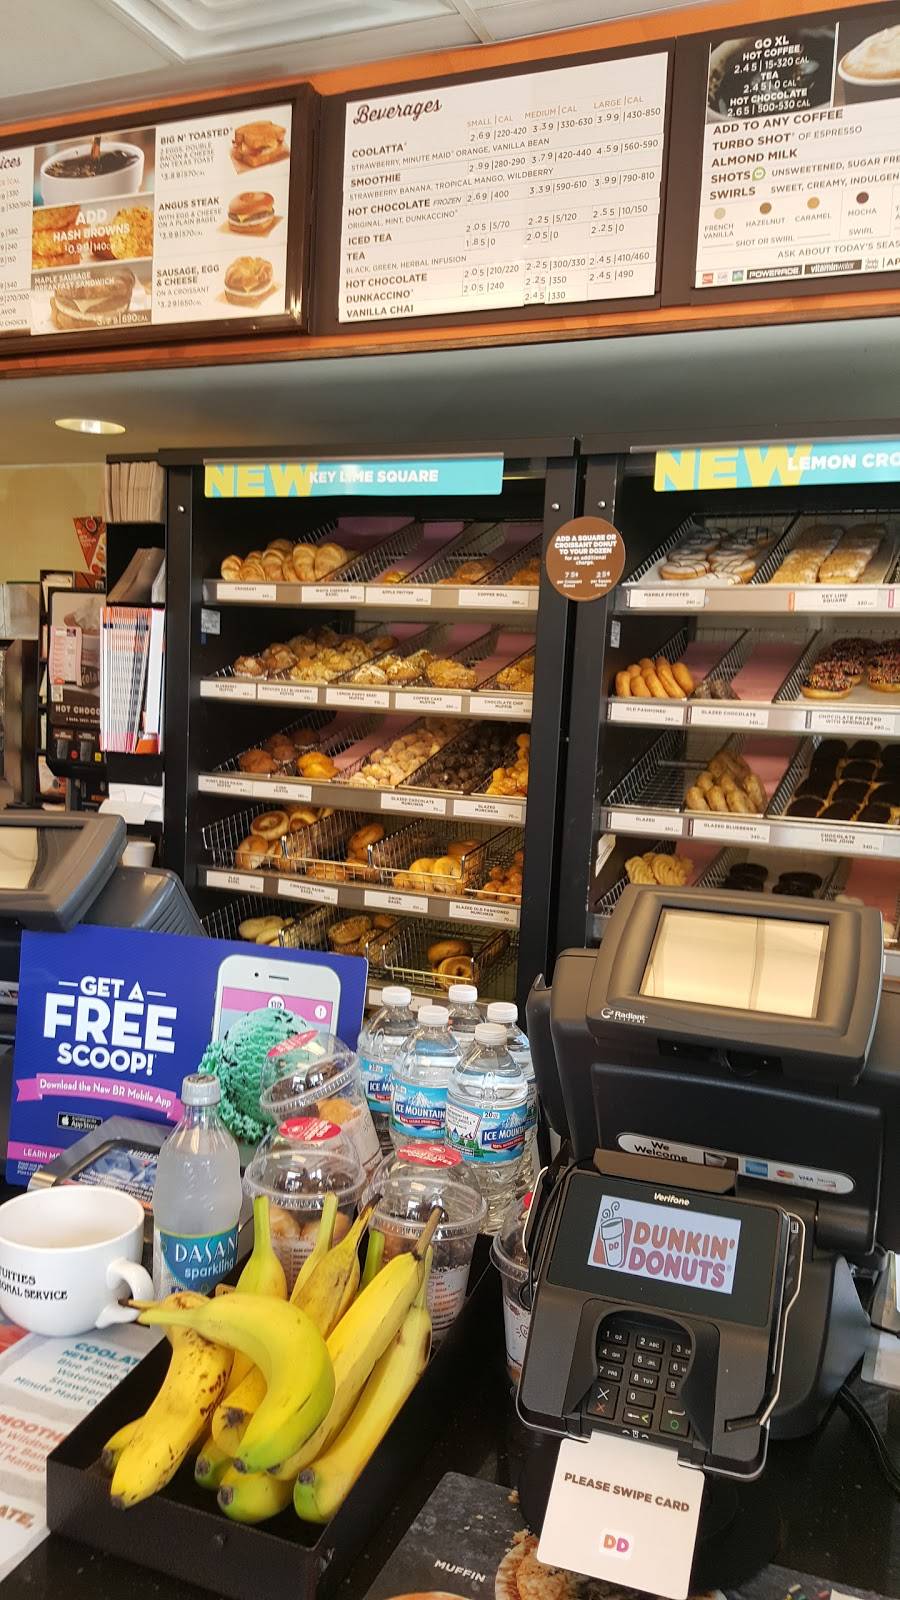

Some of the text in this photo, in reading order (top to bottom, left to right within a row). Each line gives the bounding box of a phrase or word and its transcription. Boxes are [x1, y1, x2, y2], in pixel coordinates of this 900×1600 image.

[755, 35, 790, 49] GO XL
[743, 44, 801, 61] HOT COFFEE
[761, 71, 778, 80] TEA
[730, 88, 808, 107] HOT CHOCOLATE
[353, 99, 442, 124] Beverages
[713, 108, 844, 136] ADD TO ANY COFFEE
[160, 135, 175, 145] BIG
[190, 128, 230, 140] TOASTED
[712, 138, 754, 151] TURBO
[814, 125, 862, 139] ESPRESSO
[352, 143, 404, 158] COOLATTA
[402, 155, 430, 165] MINUTE
[493, 142, 526, 152] VANILLA
[528, 138, 550, 147] BEAN
[712, 148, 798, 168] ALMOND MILK
[508, 168, 554, 180] WILDBERRY
[711, 158, 880, 184] SHOTS UNSWEETENED, SUGAR
[350, 173, 400, 188] SMOOTHIE
[710, 186, 756, 201] SWIRLS
[771, 183, 804, 194] SWEET,
[807, 178, 848, 191] CREAMY,
[159, 197, 220, 211] ANGUS STEAK
[348, 207, 368, 216] HOT
[371, 199, 430, 214] CHOCOLATE
[76, 209, 107, 226] ADD
[795, 213, 831, 222] CARAMEL
[54, 223, 130, 242] HASH BROWNS
[348, 233, 392, 246] ICED TEA
[703, 230, 734, 240] VANILLA
[347, 252, 366, 262] TEA
[778, 250, 796, 259] ASK
[800, 247, 830, 258] ABOUT
[834, 242, 874, 253] TODAY'S
[400, 260, 429, 268] HERBAL
[432, 256, 466, 265] INFUSION
[156, 264, 220, 278] SAUSAGE, EGG
[165, 276, 198, 286] CHEESE
[346, 273, 428, 288] HOT CHOCOLATE
[346, 290, 412, 304] DUNKACCINO
[347, 304, 414, 318] VANILLA CHAI
[654, 444, 814, 492] NEW
[788, 454, 856, 472] LEMON
[205, 463, 440, 498] NEW KEY LIME SQUARE
[56, 704, 70, 713] HOT
[80, 976, 144, 1001] GET A
[43, 992, 178, 1054] FREE
[614, 1011, 646, 1020] Radiant
[56, 1042, 154, 1076] SCOOP!
[40, 1078, 172, 1109] Download the New BR Mobile App
[370, 1082, 380, 1092] ICE
[396, 1102, 404, 1114] ICE
[405, 1104, 446, 1119] MOUNTAIN
[484, 1131, 497, 1142] ICE
[24, 1148, 48, 1159] LEARN
[634, 1144, 688, 1162] Welcome
[650, 1140, 670, 1151] We
[654, 1192, 690, 1206] Verifone
[633, 1221, 736, 1261] DUNKIN'
[184, 1257, 234, 1281] sparkling
[608, 1241, 726, 1288] DD DONUTS
[24, 1288, 68, 1300] SERVICE
[564, 1472, 690, 1512] PLEASE SWIPE CARD
[604, 1534, 630, 1553] DD
[434, 1560, 486, 1583] MUFFIN
